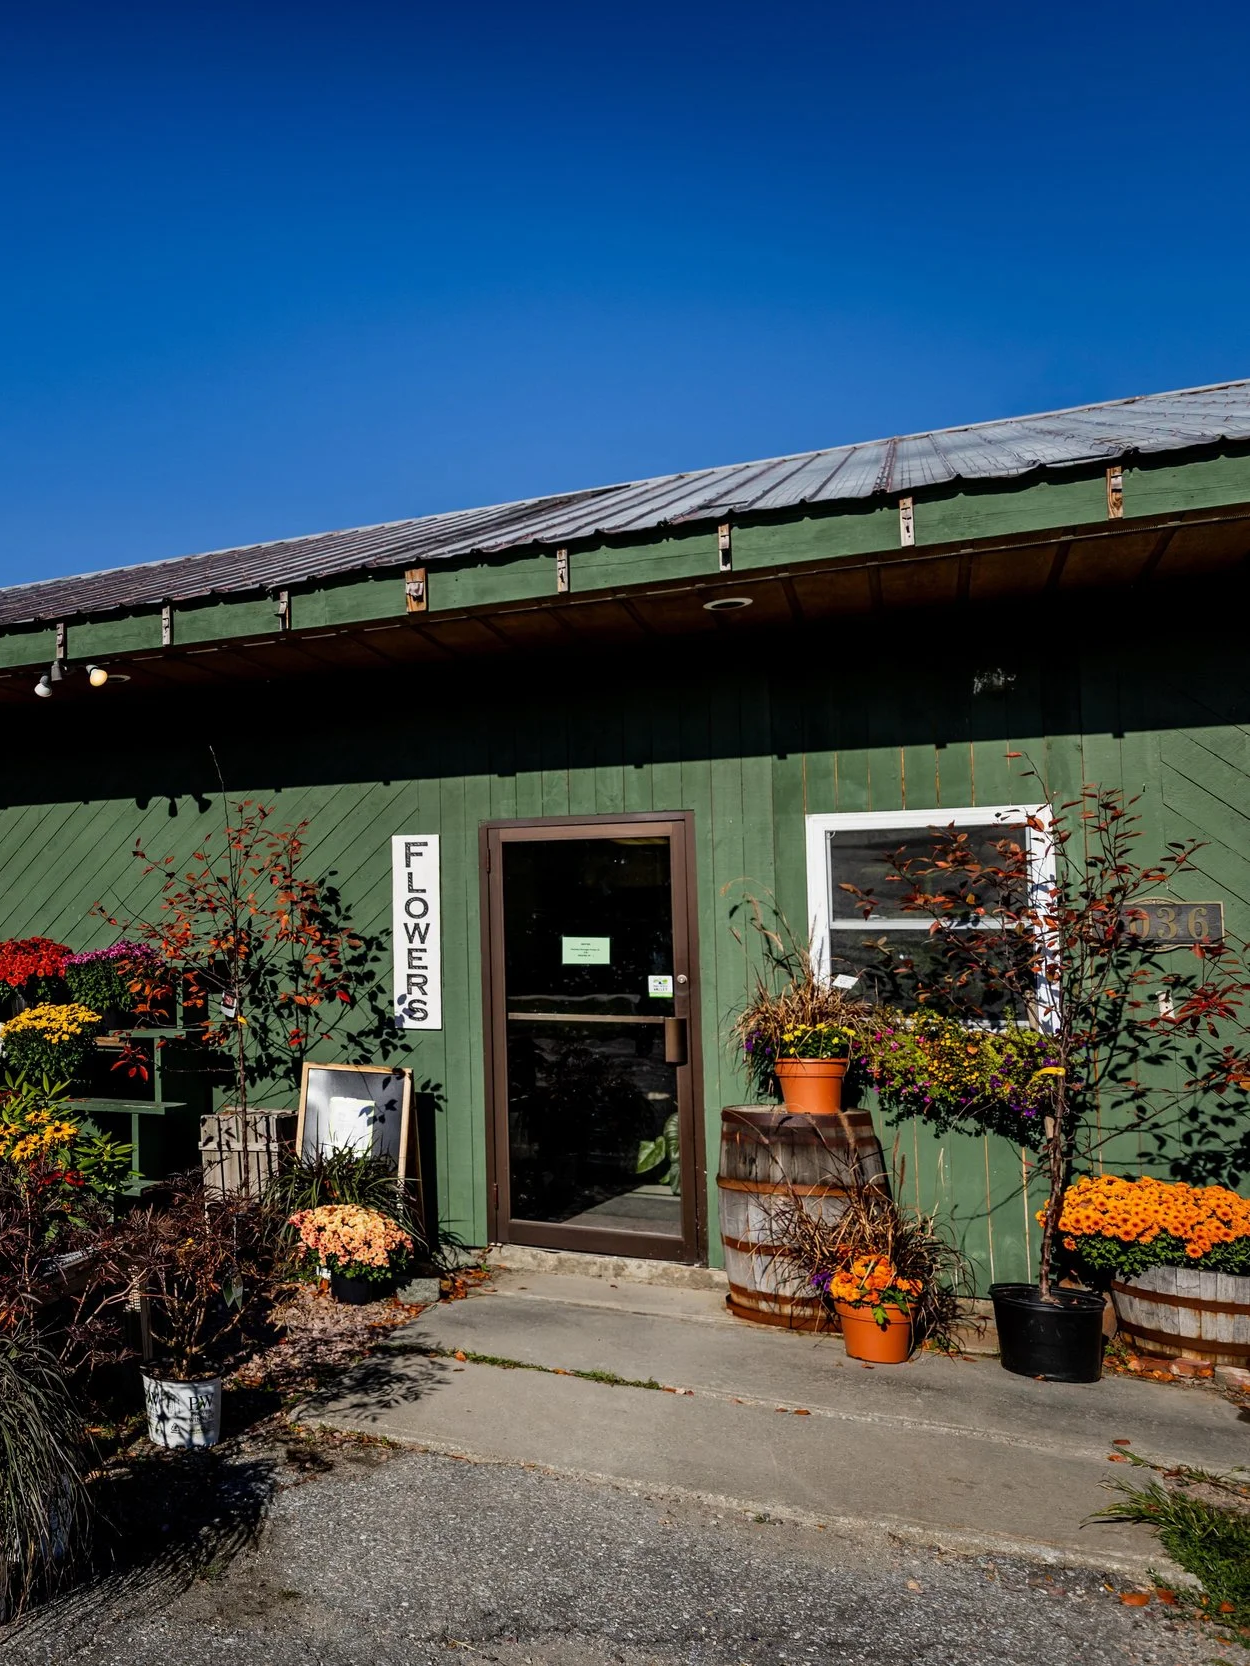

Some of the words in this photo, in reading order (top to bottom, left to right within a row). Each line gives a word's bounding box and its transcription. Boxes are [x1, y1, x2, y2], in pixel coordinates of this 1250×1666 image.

[403, 841, 431, 1022] FLOWERS
[1100, 907, 1210, 940] 036
[188, 1393, 214, 1410] PW
